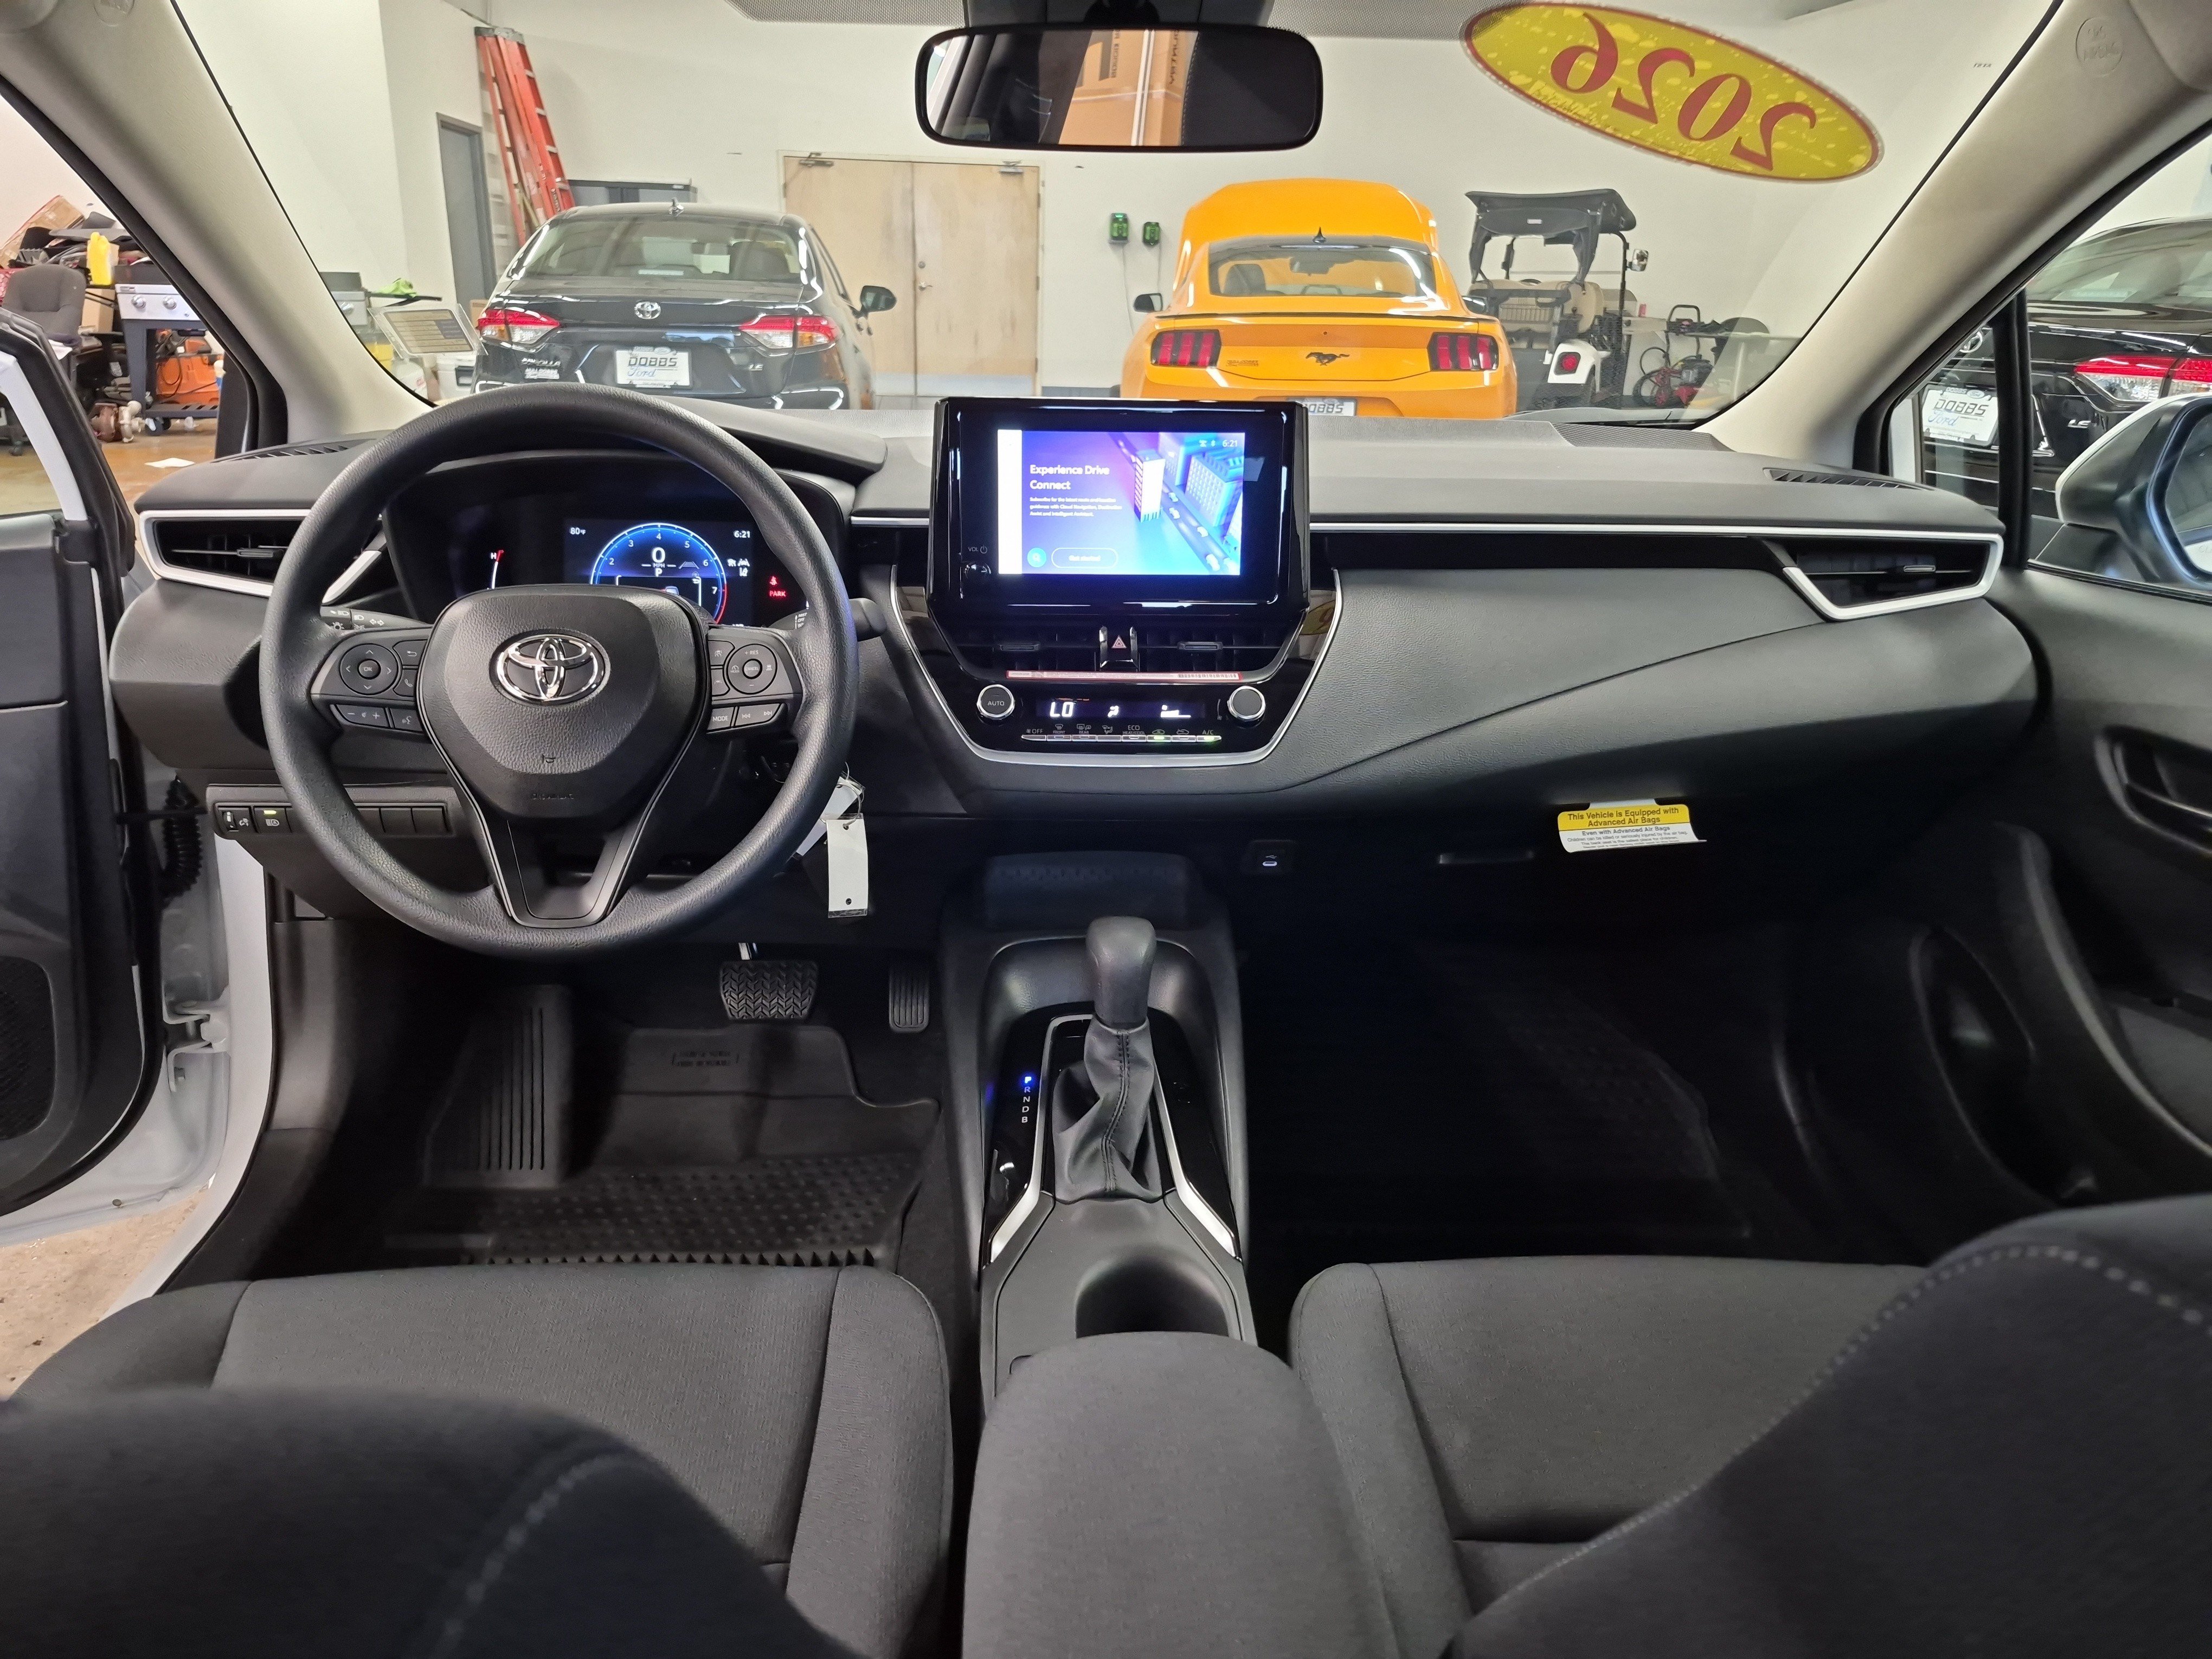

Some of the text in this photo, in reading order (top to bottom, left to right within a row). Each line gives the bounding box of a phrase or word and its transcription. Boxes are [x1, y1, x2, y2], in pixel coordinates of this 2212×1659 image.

[628, 357, 678, 366] DOBBS
[627, 366, 658, 377] Ford
[1304, 403, 1345, 414] OBBS
[1933, 398, 1989, 416] DOBBS
[1927, 410, 1960, 426] Ford
[2067, 419, 2091, 428] LE
[1030, 464, 1110, 476] Experience Drive
[1030, 480, 1071, 490] Connect
[628, 539, 634, 548] 3
[685, 541, 690, 549] 5
[652, 547, 666, 563] 0
[609, 557, 614, 565] 2
[655, 568, 663, 577] P
[712, 586, 718, 594] 7
[1050, 702, 1074, 717] LO
[1586, 811, 1614, 820] Vehicle
[1625, 808, 1661, 821] Equipped
[1587, 818, 1626, 827] Advanced
[1641, 815, 1661, 824] Bags
